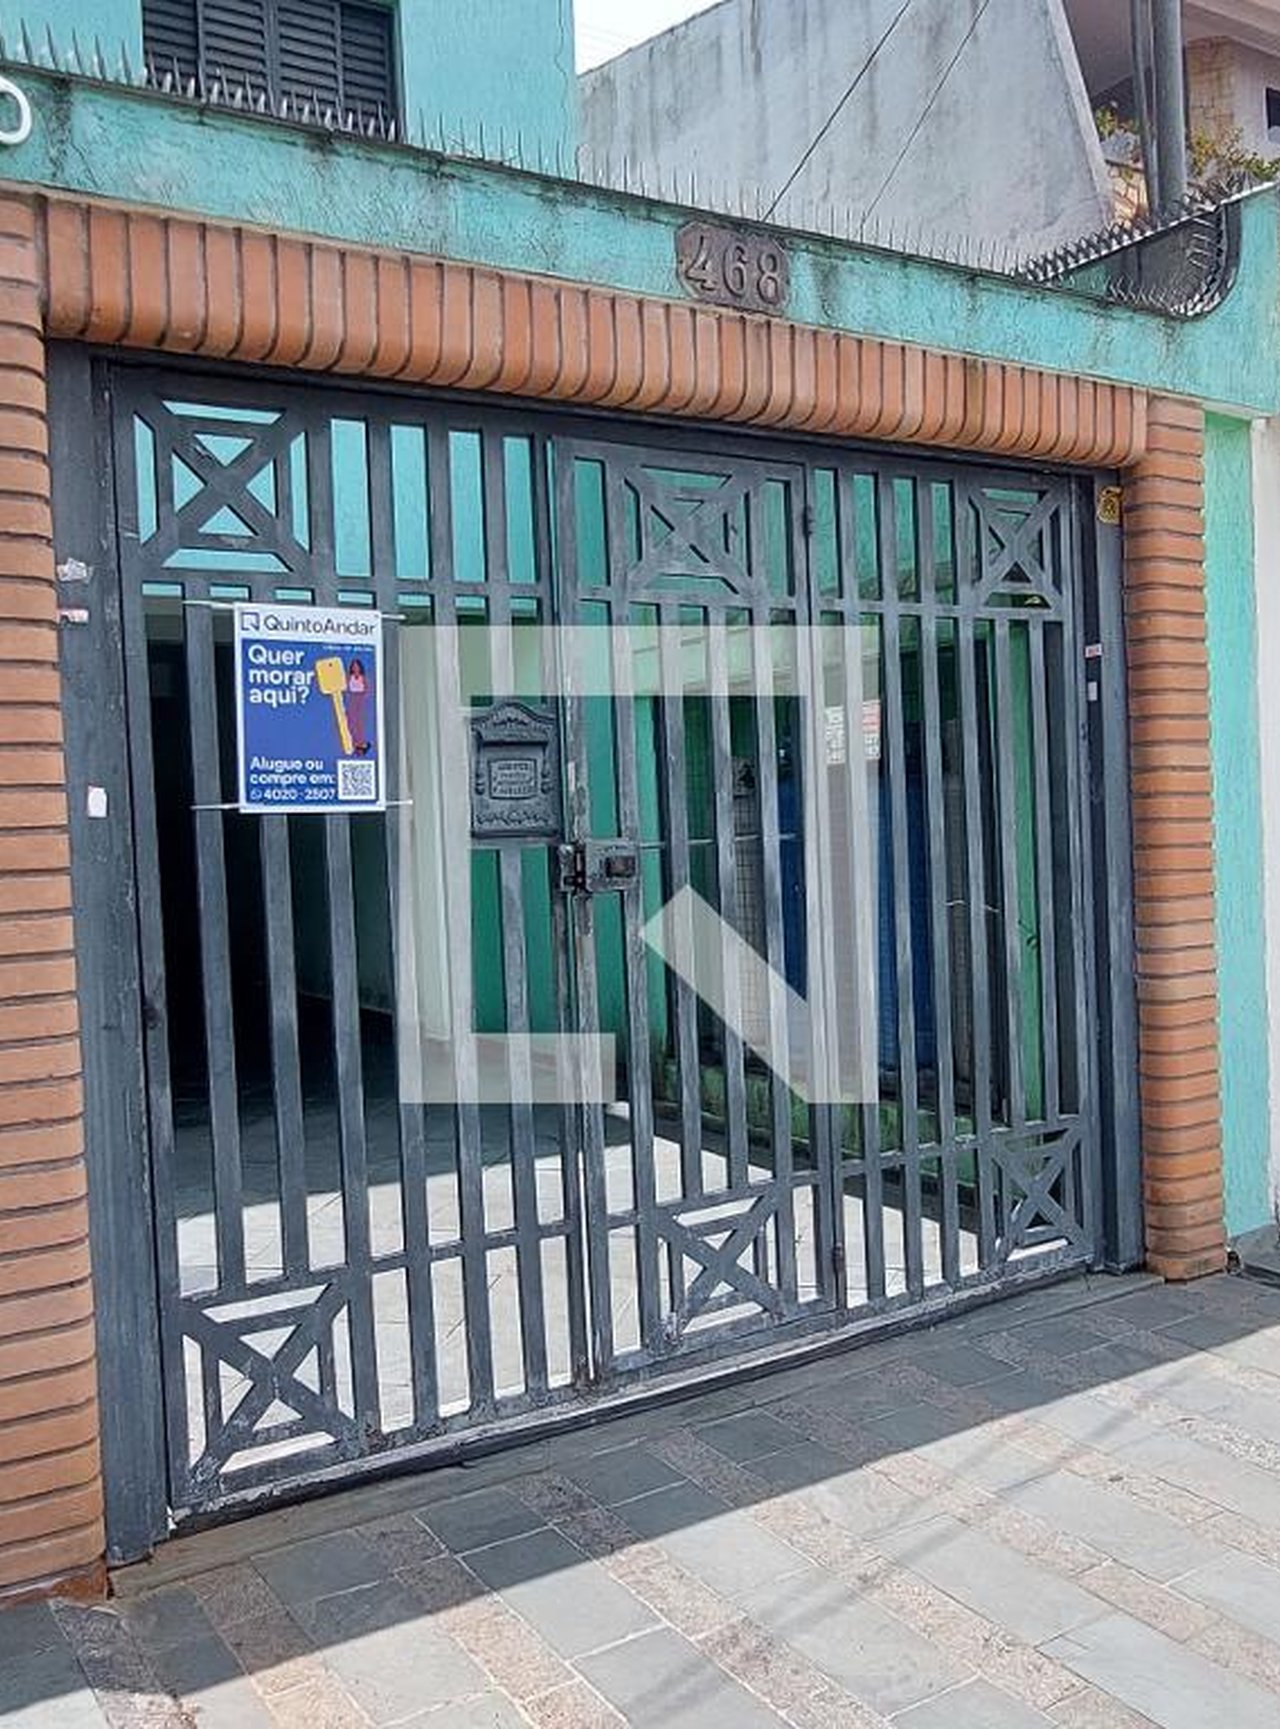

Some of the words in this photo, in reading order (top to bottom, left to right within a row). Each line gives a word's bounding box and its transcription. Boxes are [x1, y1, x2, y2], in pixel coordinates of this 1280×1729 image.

[684, 233, 781, 305] 468
[263, 614, 376, 636] QuintoAndar
[248, 644, 305, 665] Quer
[248, 668, 314, 686] morar
[249, 686, 310, 708] aqui?
[250, 756, 303, 773] Alugue
[305, 759, 324, 771] ou
[249, 773, 307, 787] compre
[309, 774, 337, 785] em:
